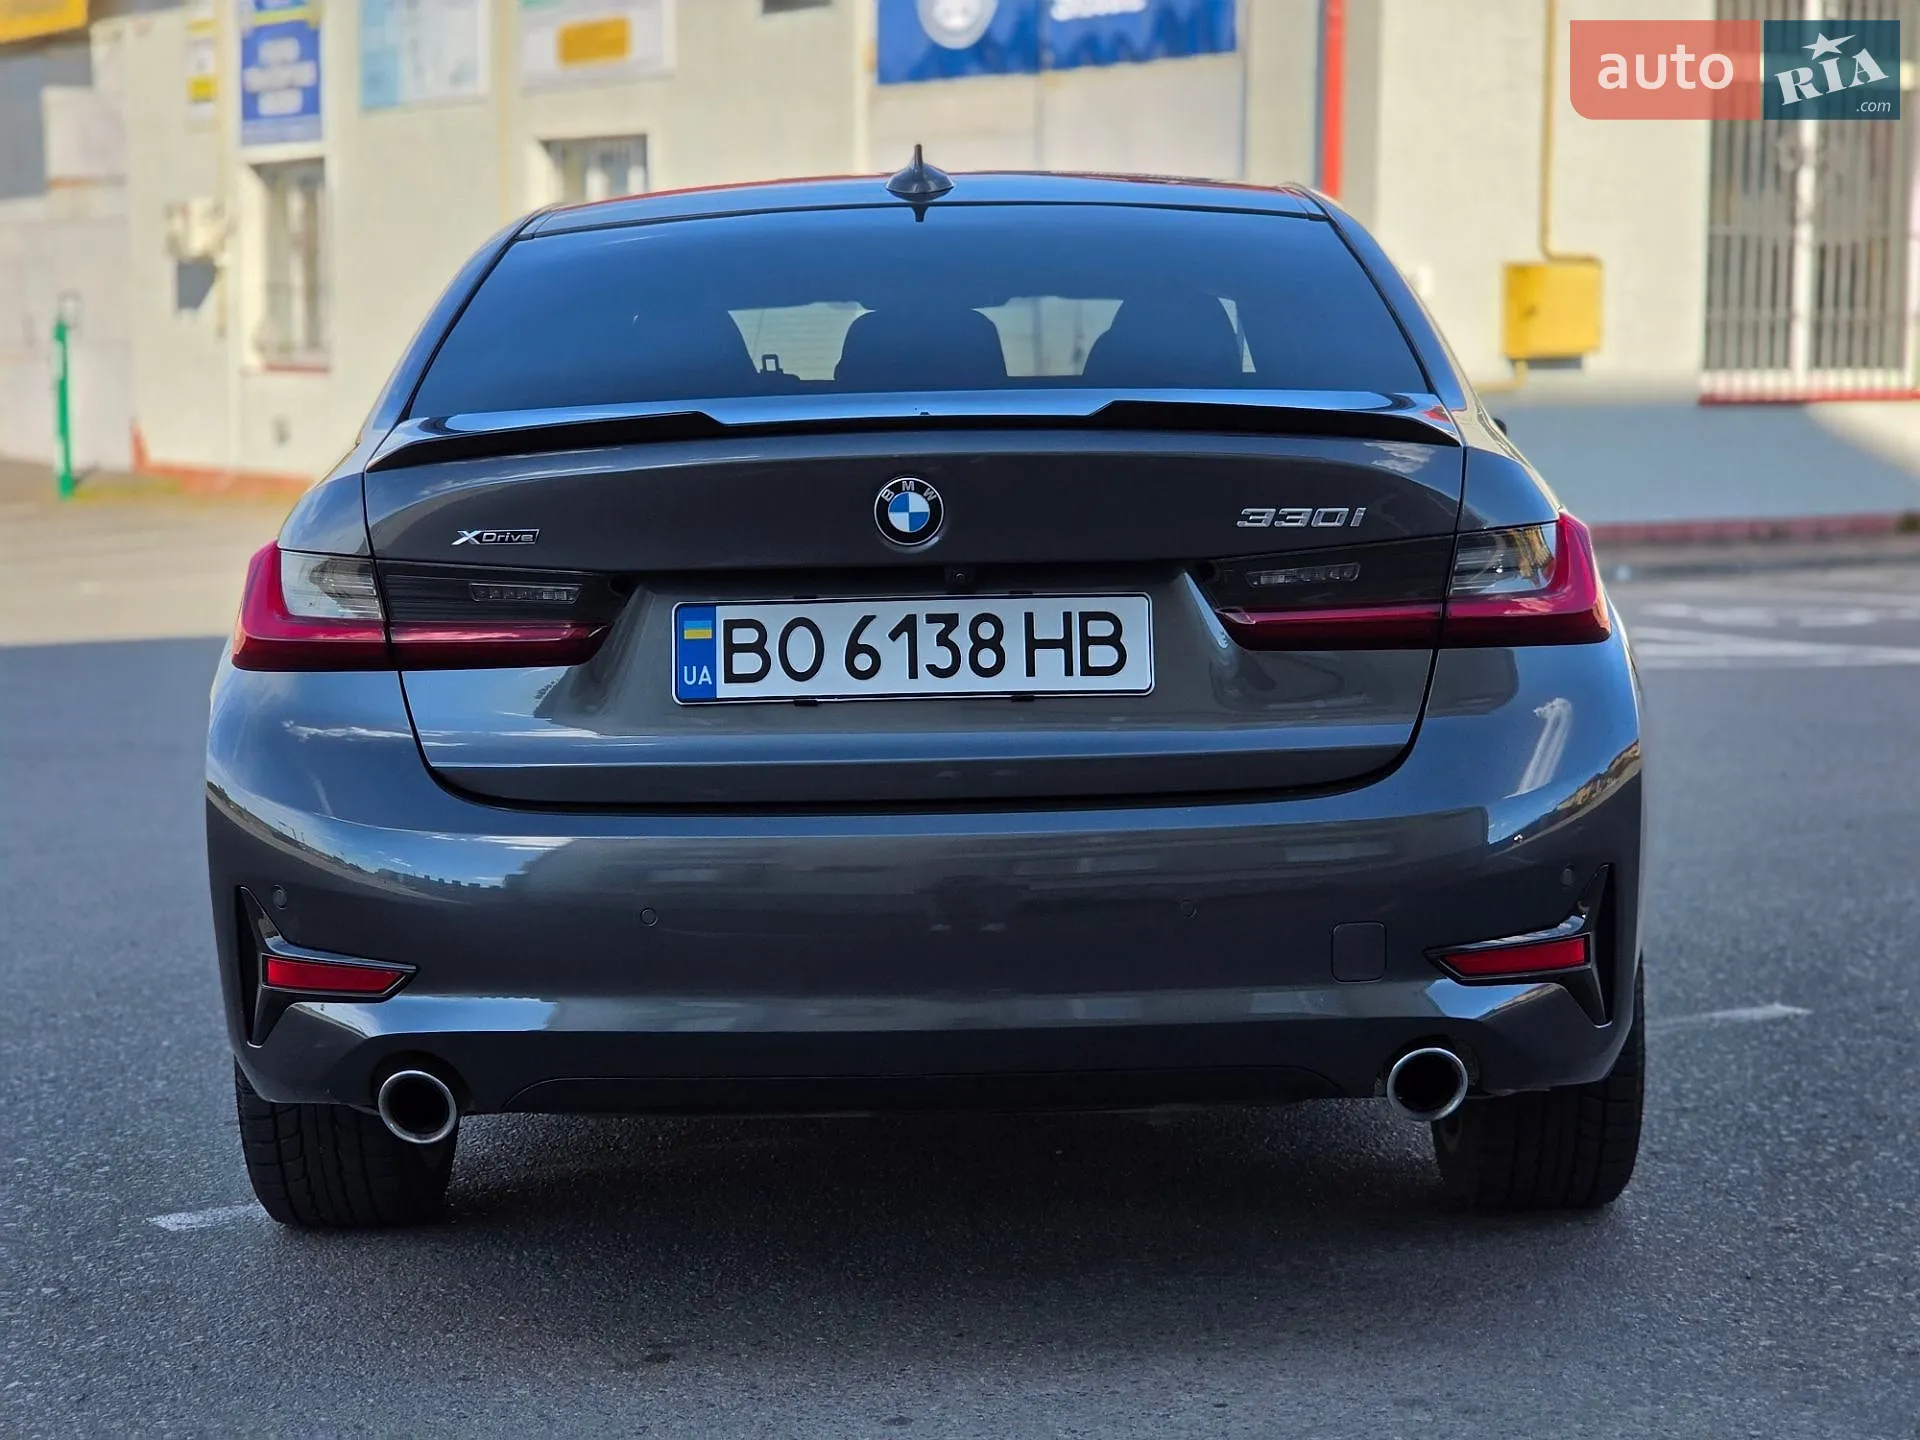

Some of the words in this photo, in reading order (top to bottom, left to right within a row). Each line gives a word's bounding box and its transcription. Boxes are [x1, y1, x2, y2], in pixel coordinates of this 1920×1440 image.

[879, 480, 938, 502] BMW
[1236, 507, 1367, 528] 330i
[722, 615, 826, 685] BO
[844, 612, 1006, 681] 6138
[1023, 611, 1128, 678] HB
[683, 665, 713, 686] UA
